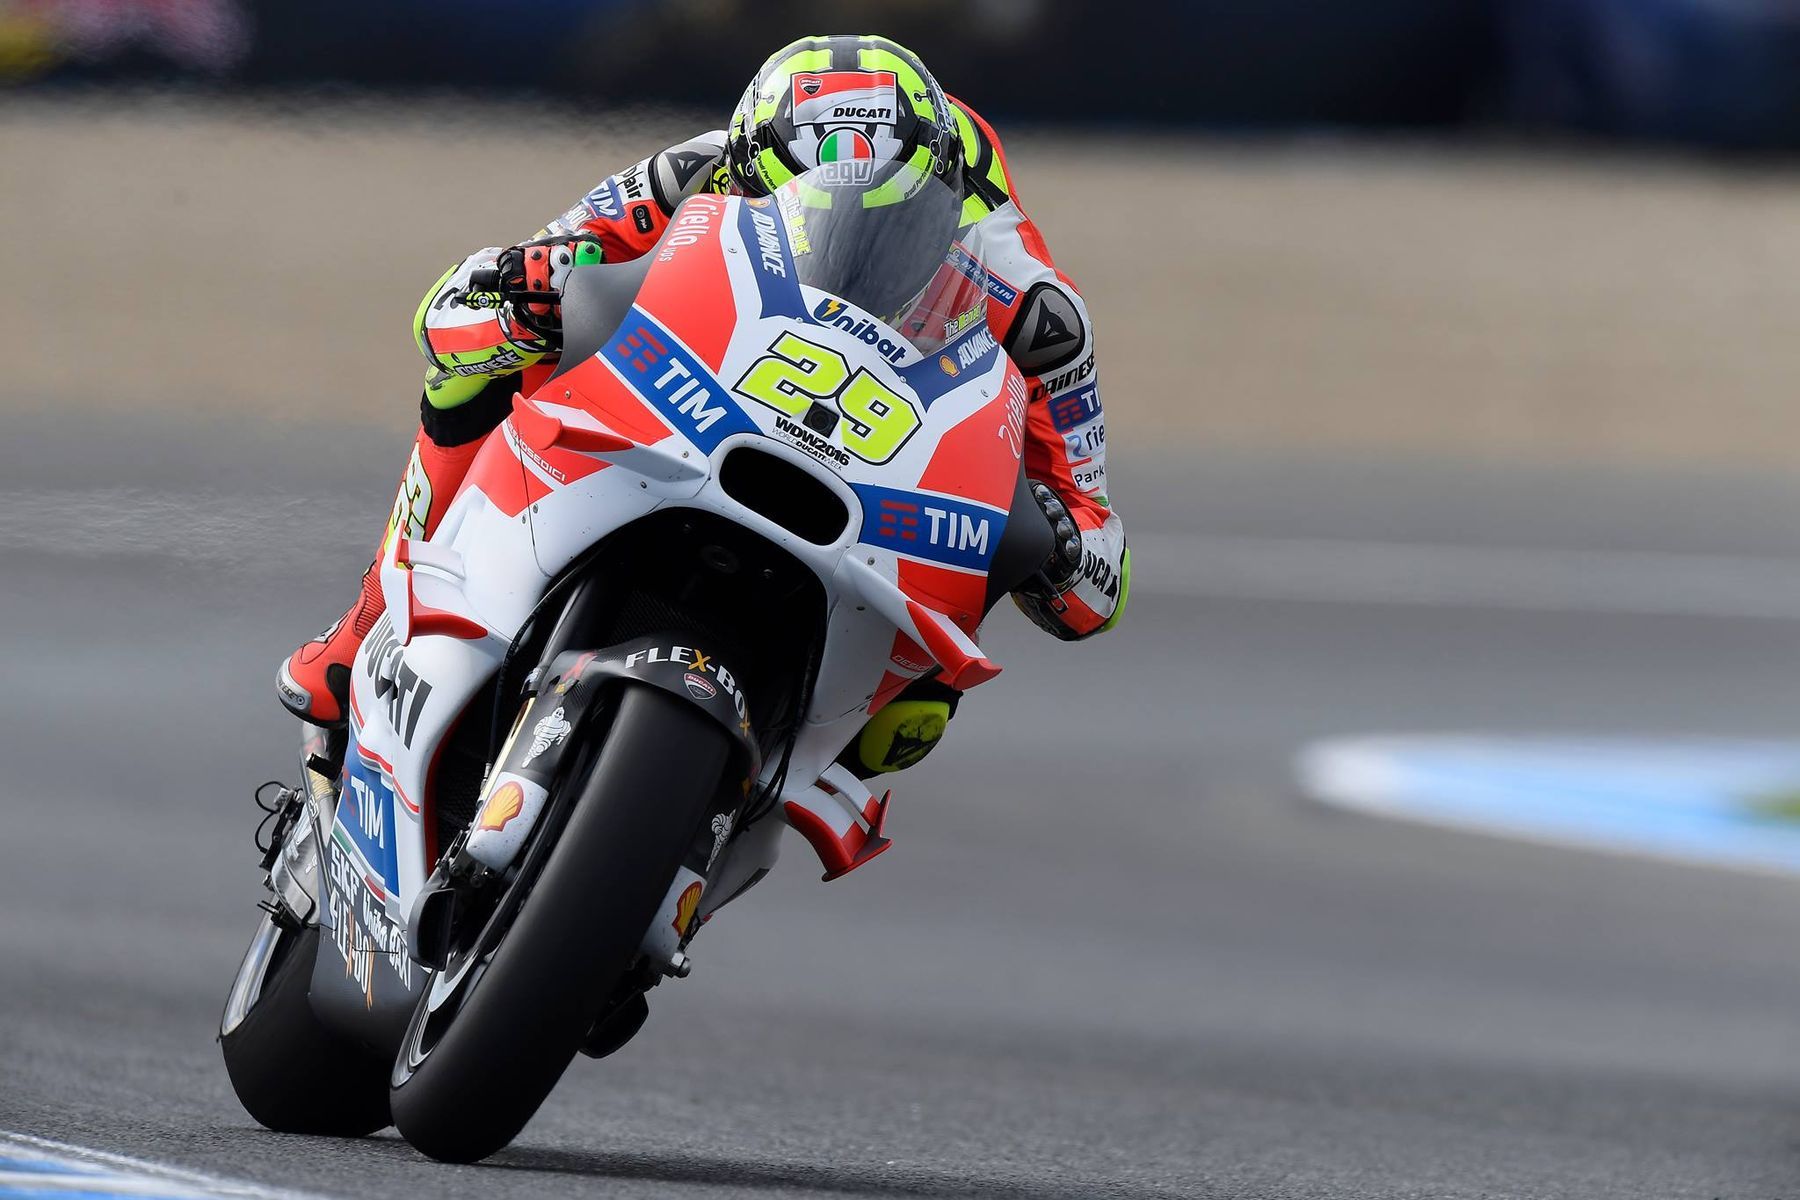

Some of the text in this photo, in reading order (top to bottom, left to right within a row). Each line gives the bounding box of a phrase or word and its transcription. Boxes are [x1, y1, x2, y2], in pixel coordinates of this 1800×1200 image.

[833, 107, 891, 119] DUCATI
[588, 180, 618, 216] TIM
[749, 207, 787, 279] ADVANCE
[813, 298, 907, 364] Unibat
[653, 358, 728, 434] TIM
[731, 330, 923, 467] 29
[775, 415, 851, 466] WDW2016
[924, 507, 989, 556] TIM
[625, 646, 751, 738] FLEX-BOX
[687, 674, 715, 693] DUCATI
[351, 775, 385, 850] TIM
[331, 840, 360, 907] SKF
